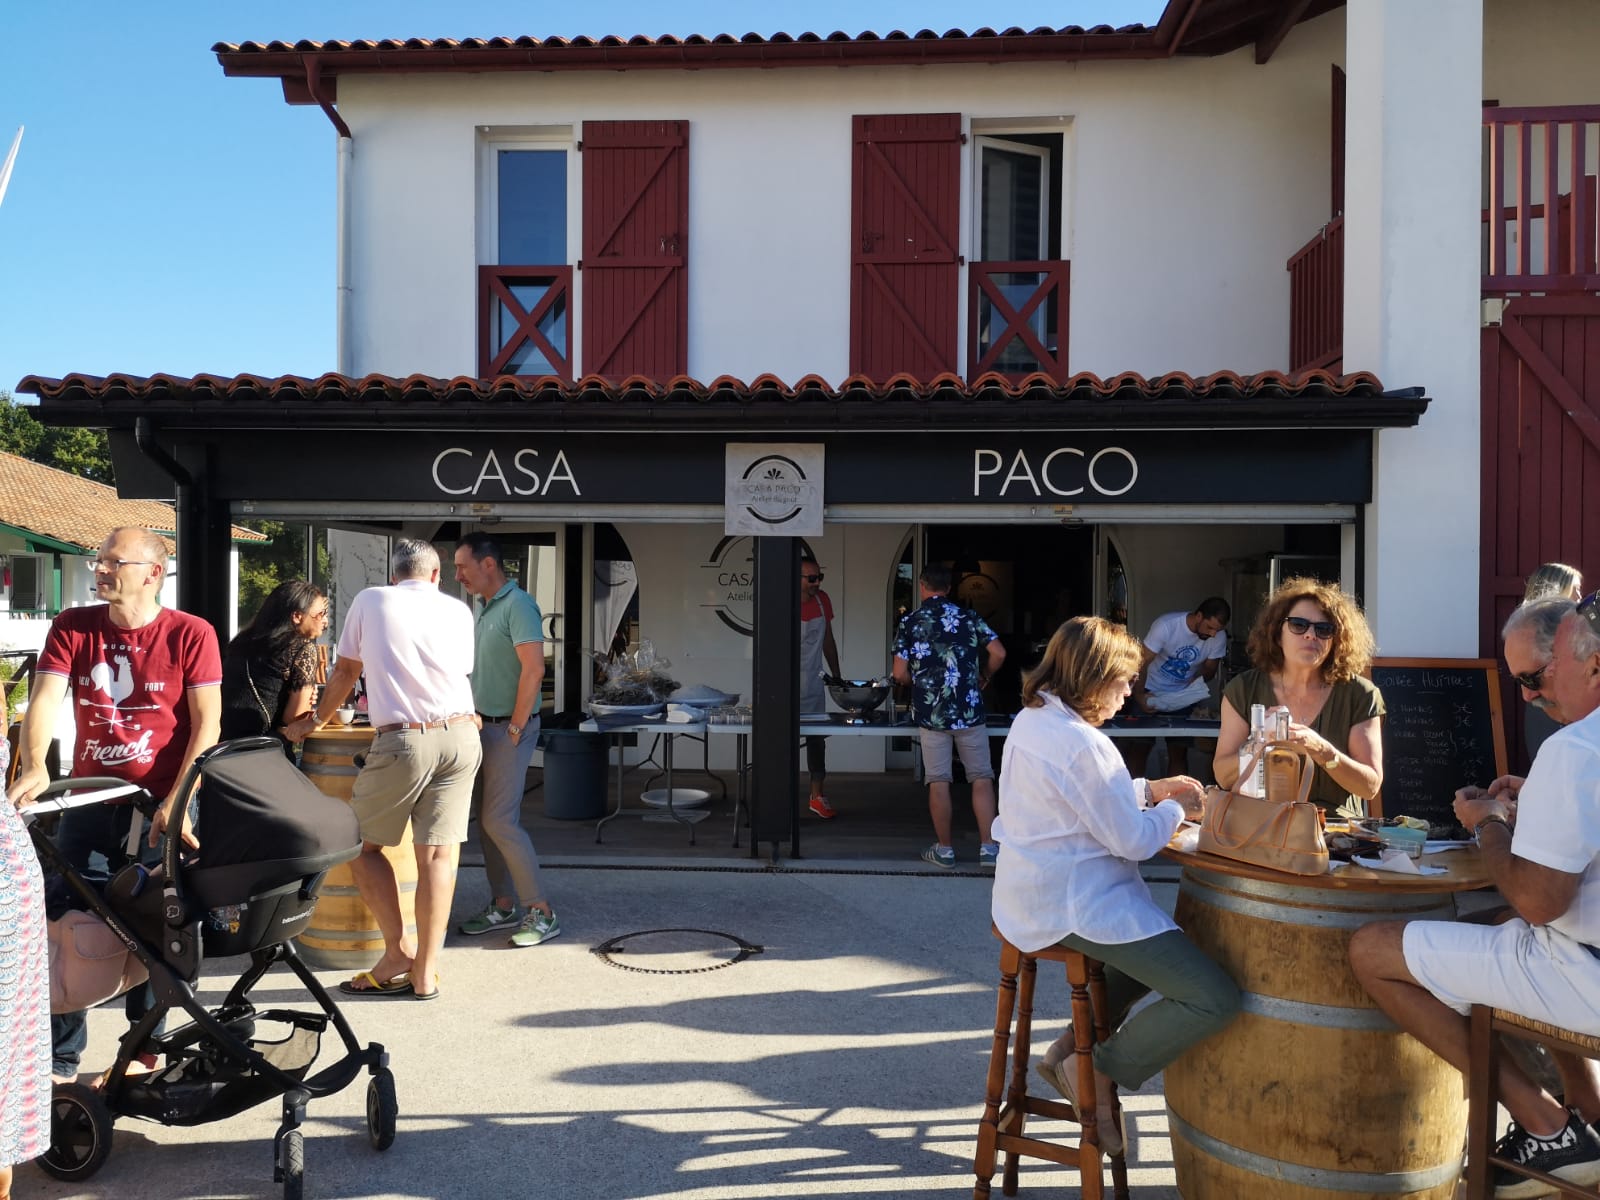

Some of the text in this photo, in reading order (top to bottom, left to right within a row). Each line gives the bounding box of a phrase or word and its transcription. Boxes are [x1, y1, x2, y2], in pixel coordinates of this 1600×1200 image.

[432, 446, 1139, 496] CASA PACO
[775, 484, 801, 495] PACO
[102, 643, 142, 653] RUGBY
[144, 682, 166, 692] FORT
[81, 729, 154, 762] French
[486, 911, 505, 924] N
[535, 921, 550, 934] N
